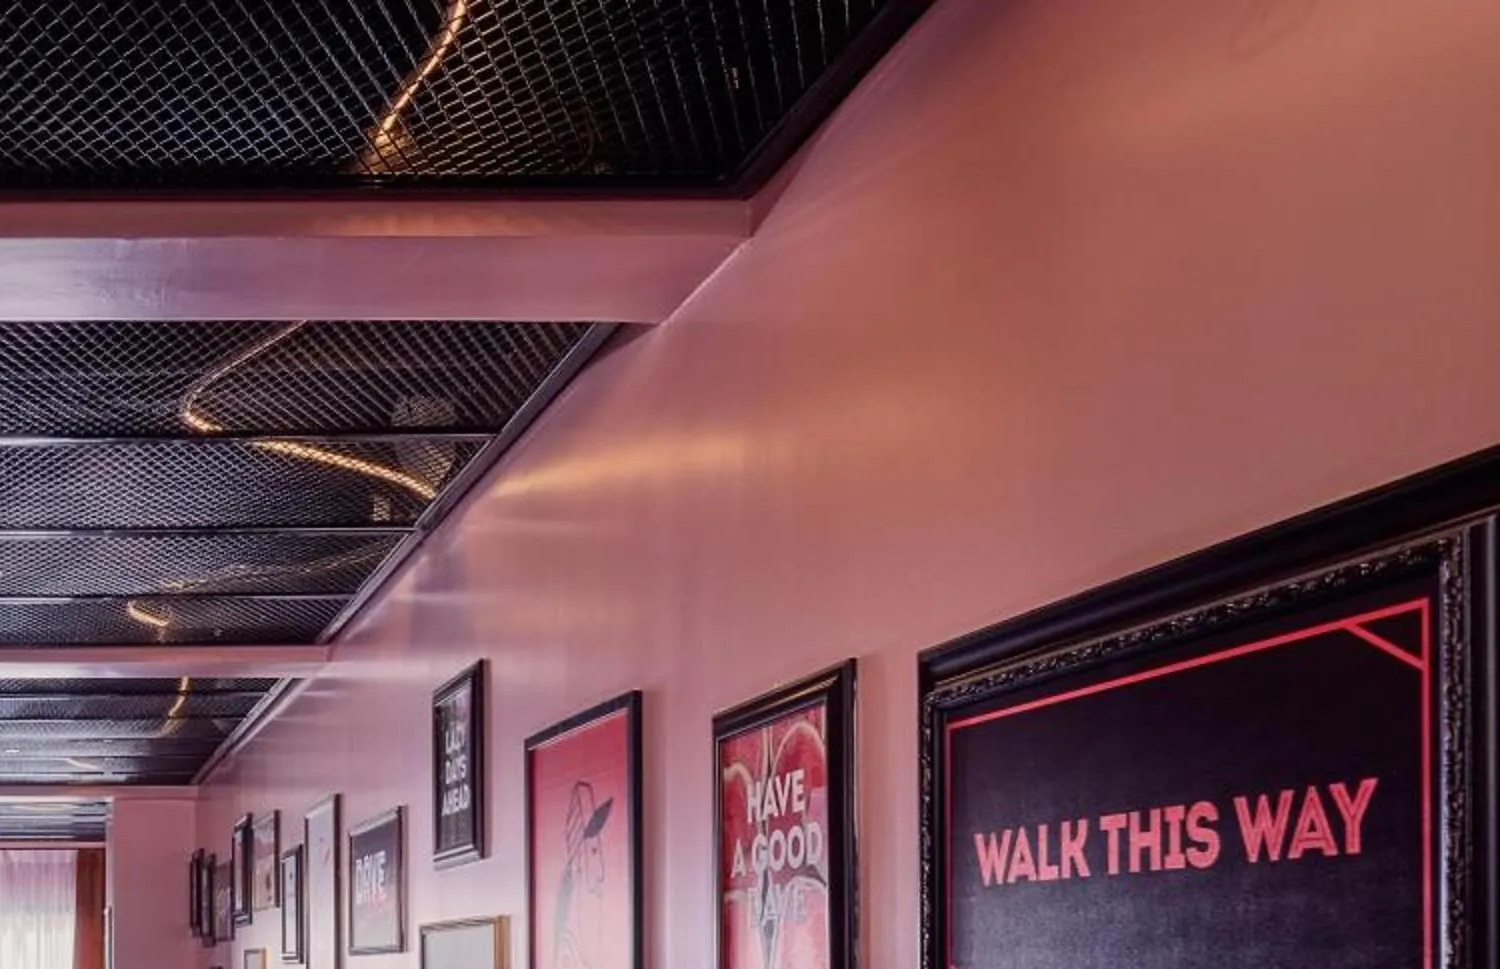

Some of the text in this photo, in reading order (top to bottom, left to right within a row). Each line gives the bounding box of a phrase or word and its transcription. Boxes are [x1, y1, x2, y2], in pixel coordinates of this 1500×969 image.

[442, 783, 471, 817] AHEAD
[746, 767, 806, 824] HAVE
[731, 821, 824, 879] A GOOD
[974, 777, 1381, 888] WALK THIS WAY
[746, 883, 807, 929] DAVE
